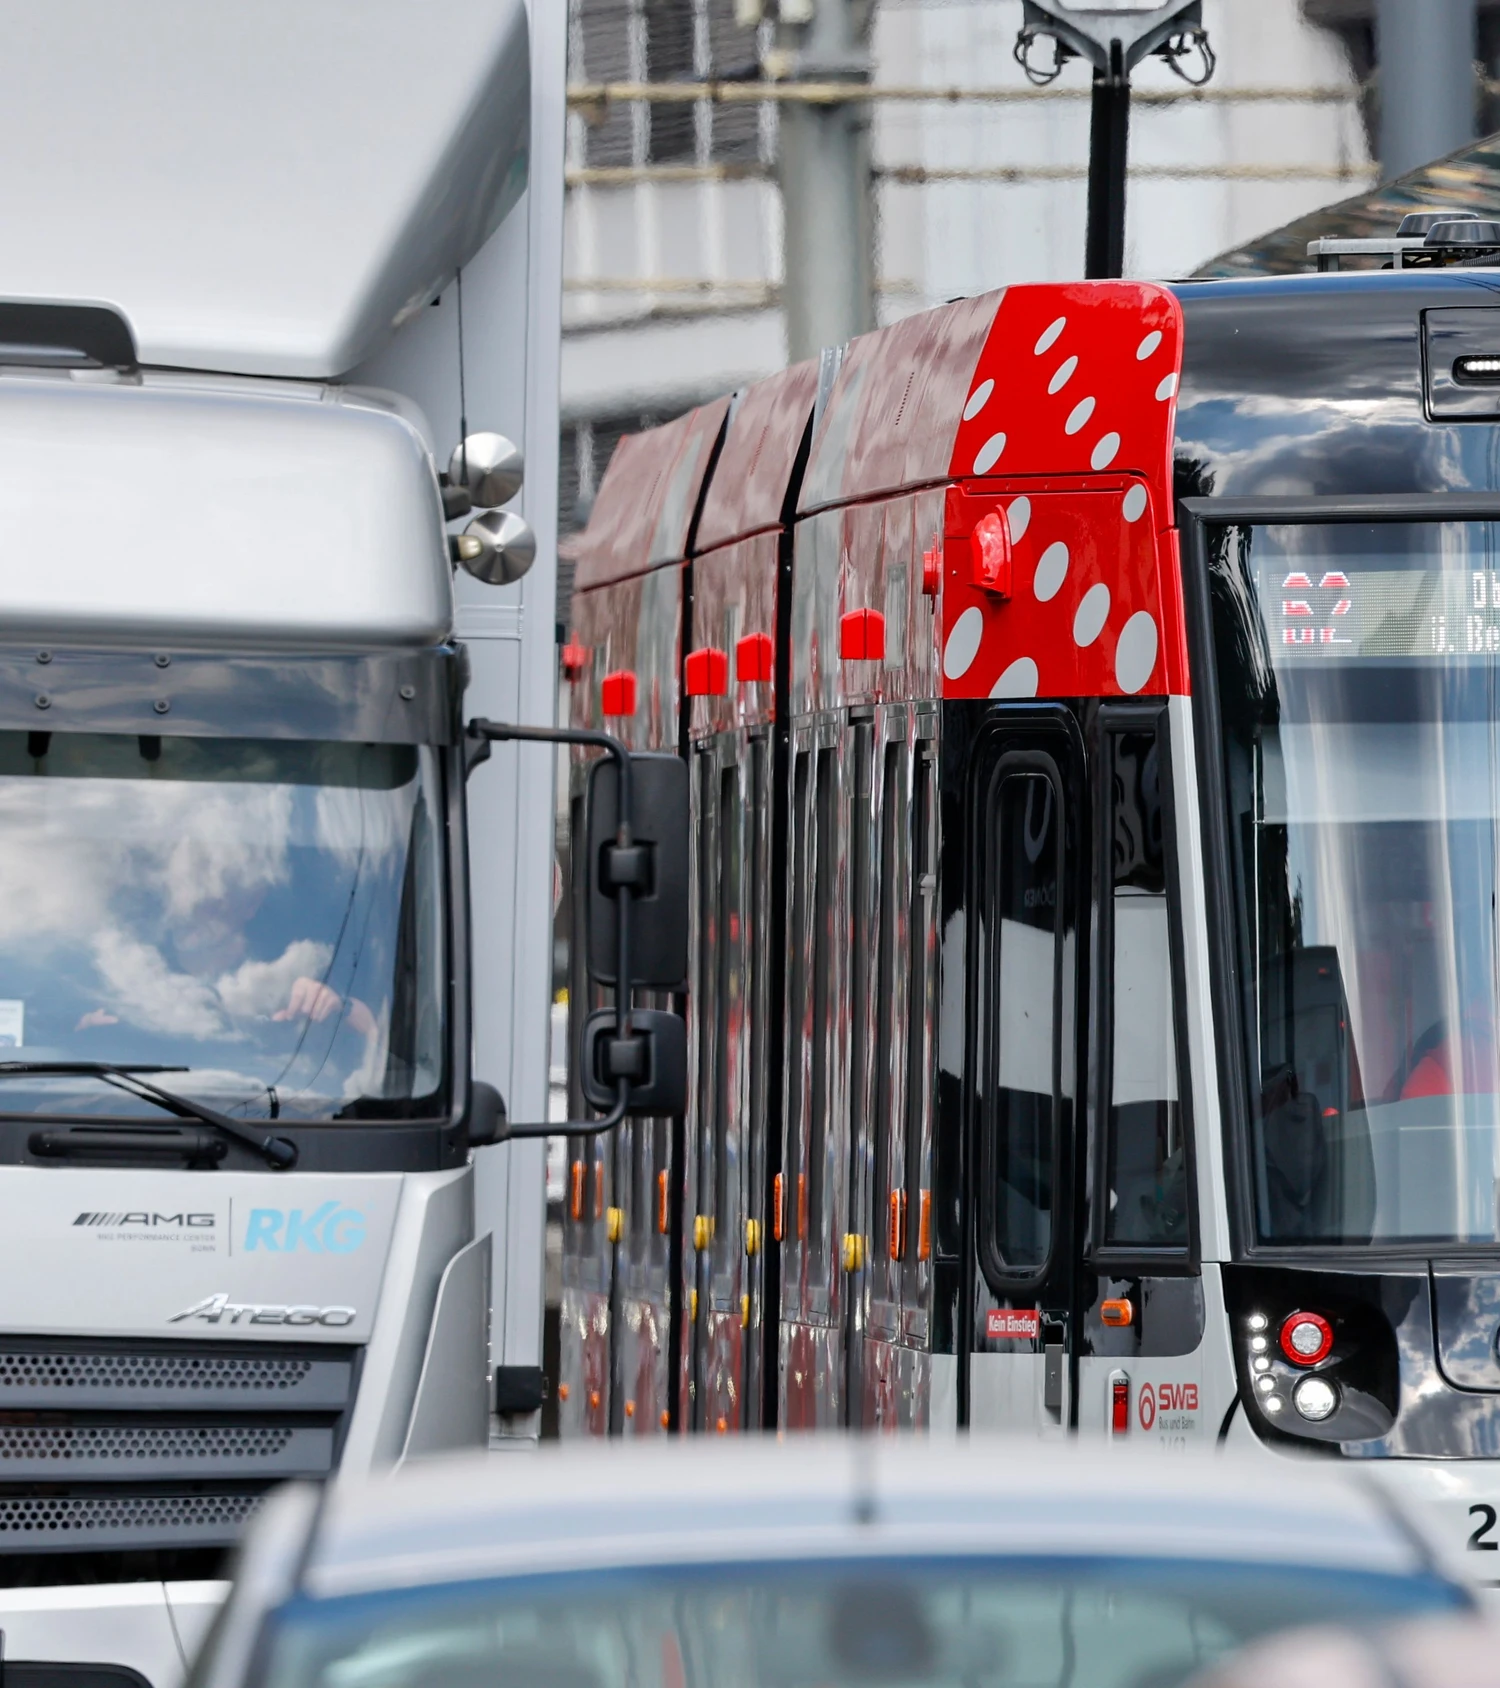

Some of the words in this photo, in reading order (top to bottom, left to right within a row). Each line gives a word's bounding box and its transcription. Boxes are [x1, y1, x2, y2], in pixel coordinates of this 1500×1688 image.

[1282, 572, 1352, 644] 62
[119, 1212, 216, 1227] AMG
[244, 1200, 367, 1254] RKG
[989, 1315, 1006, 1331] Kein
[1007, 1315, 1037, 1337] Einstieg
[1159, 1384, 1198, 1411] SWB
[1159, 1416, 1169, 1430] Bus
[1170, 1416, 1181, 1430] und
[1182, 1415, 1196, 1430] Bahn
